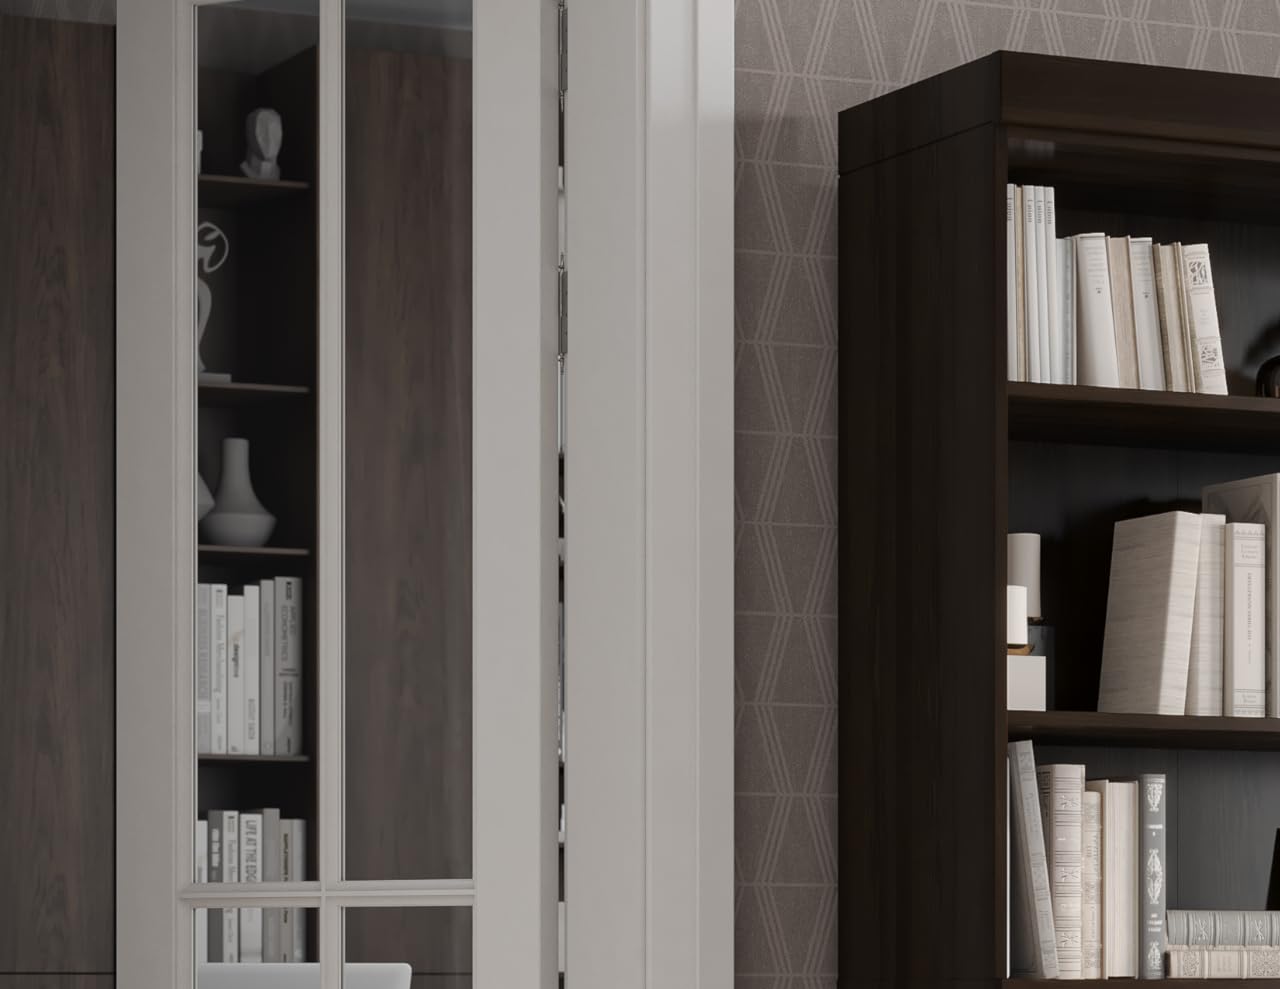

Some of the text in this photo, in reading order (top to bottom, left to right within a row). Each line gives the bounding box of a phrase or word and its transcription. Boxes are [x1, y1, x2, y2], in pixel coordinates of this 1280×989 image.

[245, 820, 257, 836] LIFE
[245, 837, 257, 847] AT
[245, 849, 257, 864] THE
